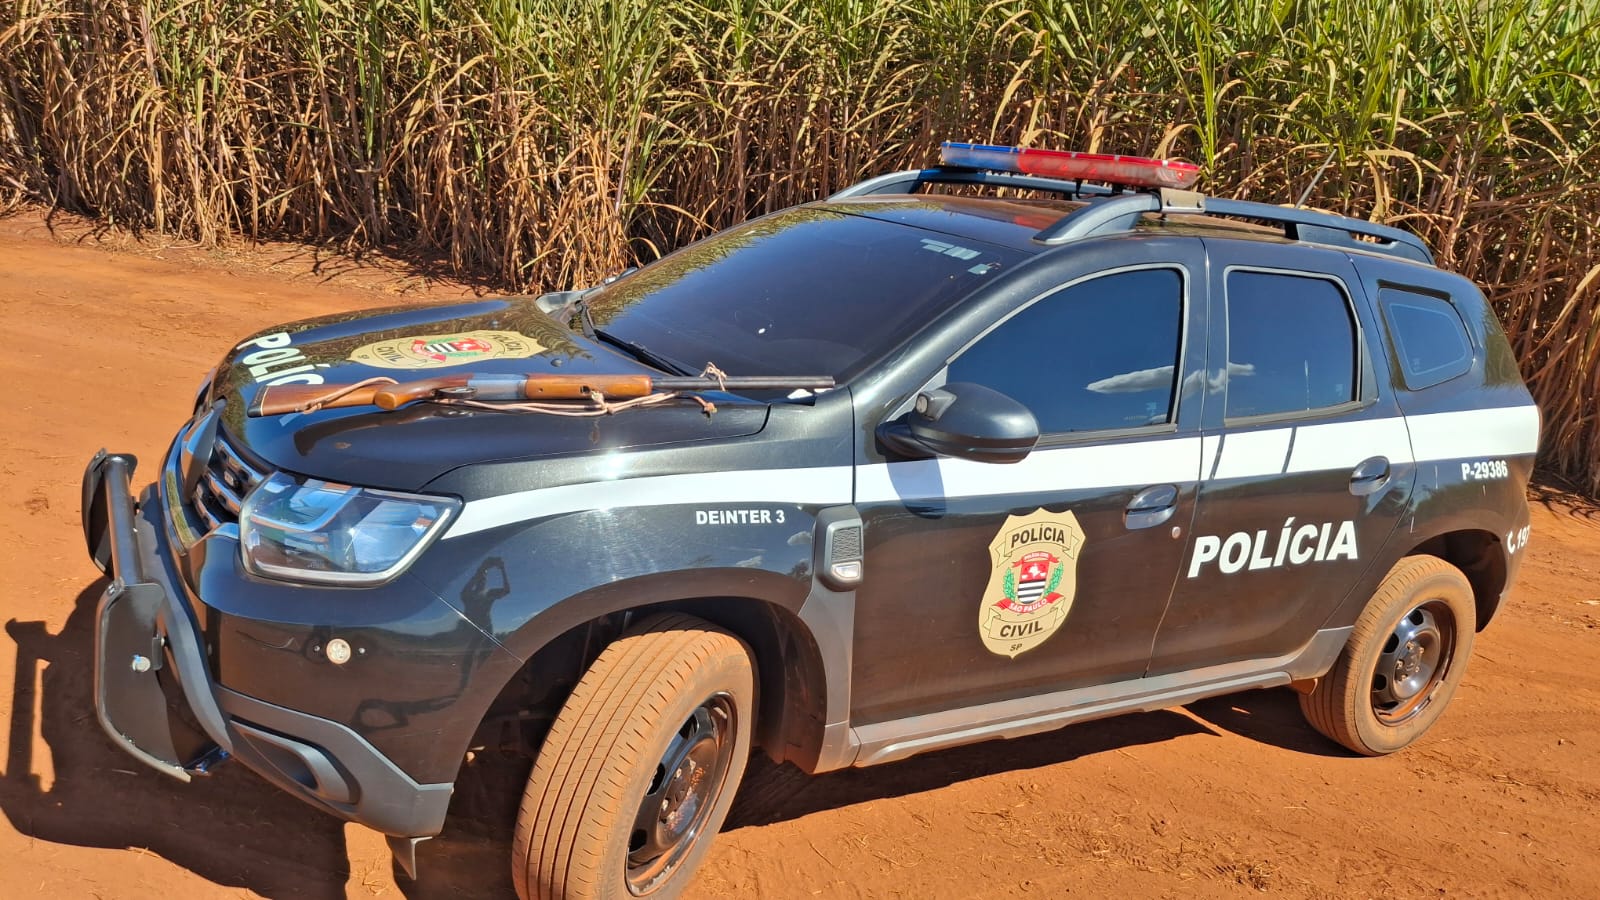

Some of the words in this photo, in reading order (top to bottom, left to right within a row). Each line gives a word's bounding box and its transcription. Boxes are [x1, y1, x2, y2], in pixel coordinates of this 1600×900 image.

[1461, 460, 1509, 481] P-29386
[696, 510, 772, 524] DEINTER
[776, 510, 785, 523] 3
[1011, 524, 1065, 549] POLÍCIA
[1187, 516, 1359, 579] POLÍCIA
[1023, 599, 1047, 612] PAULO
[1000, 620, 1043, 637] CIVIL
[1010, 643, 1023, 652] SP
